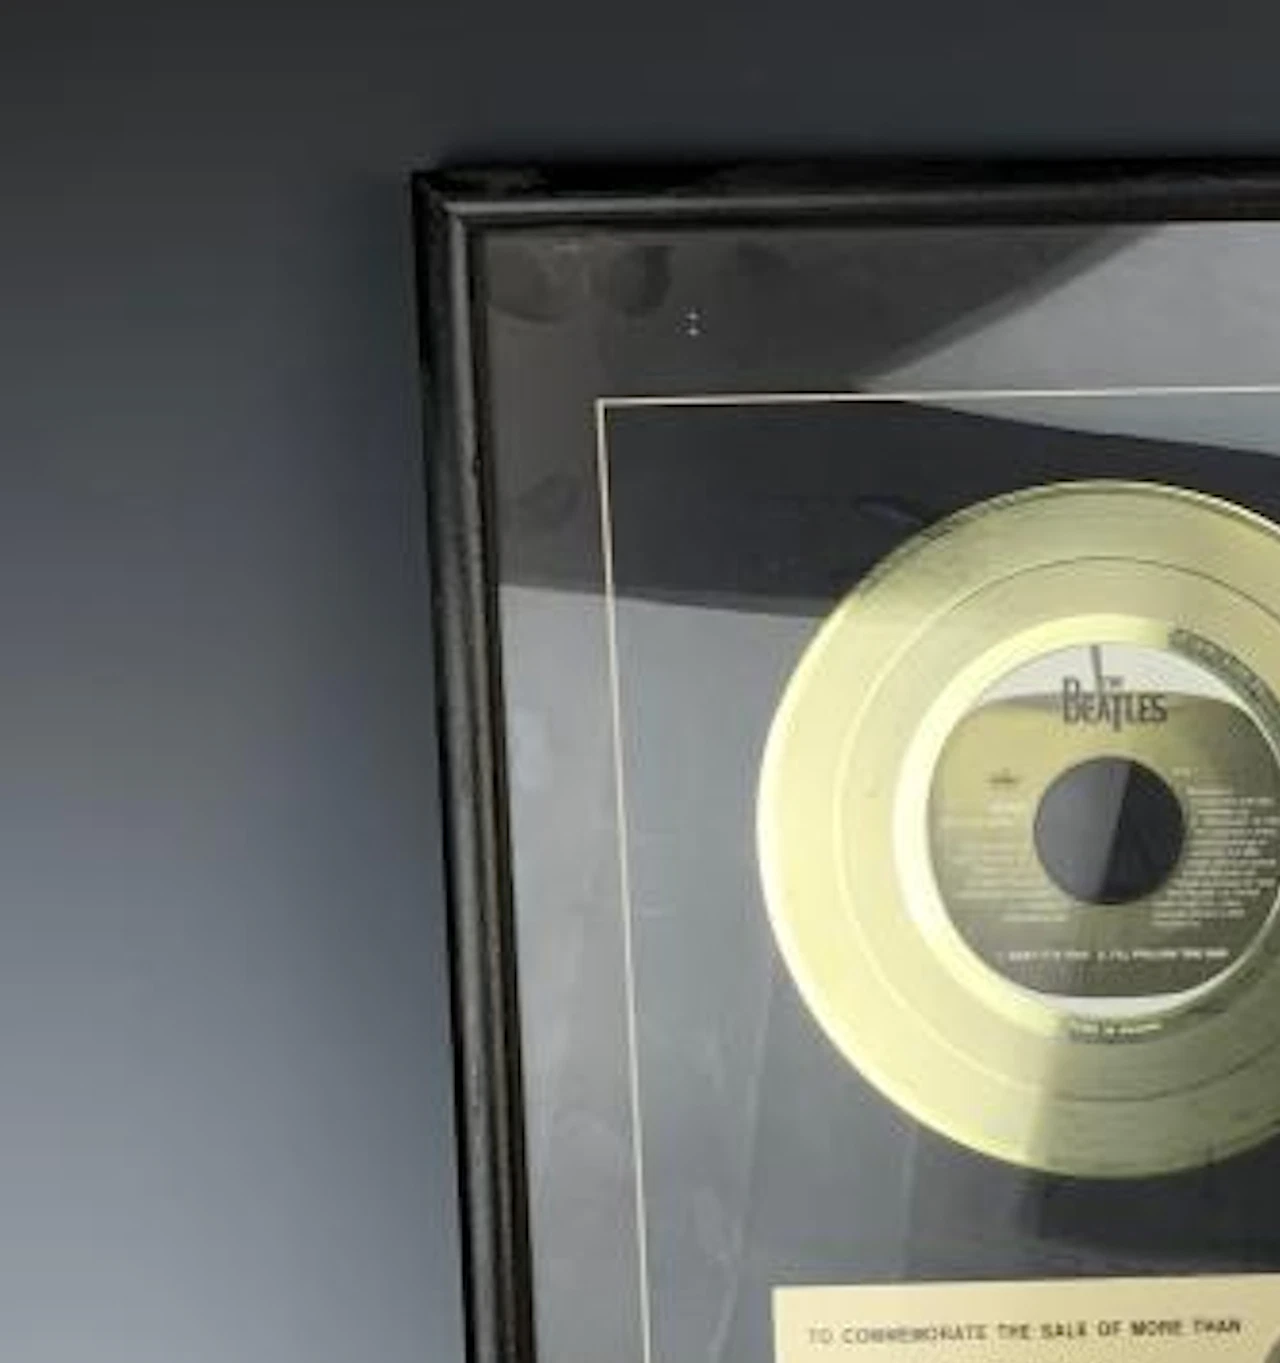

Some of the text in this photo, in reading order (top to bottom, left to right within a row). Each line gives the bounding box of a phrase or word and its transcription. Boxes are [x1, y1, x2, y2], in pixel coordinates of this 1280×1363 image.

[1062, 676, 1168, 733] BEATLES
[1041, 1321, 1087, 1339] SALE
[1098, 1320, 1124, 1337] OF
[1130, 1319, 1182, 1337] MORE
